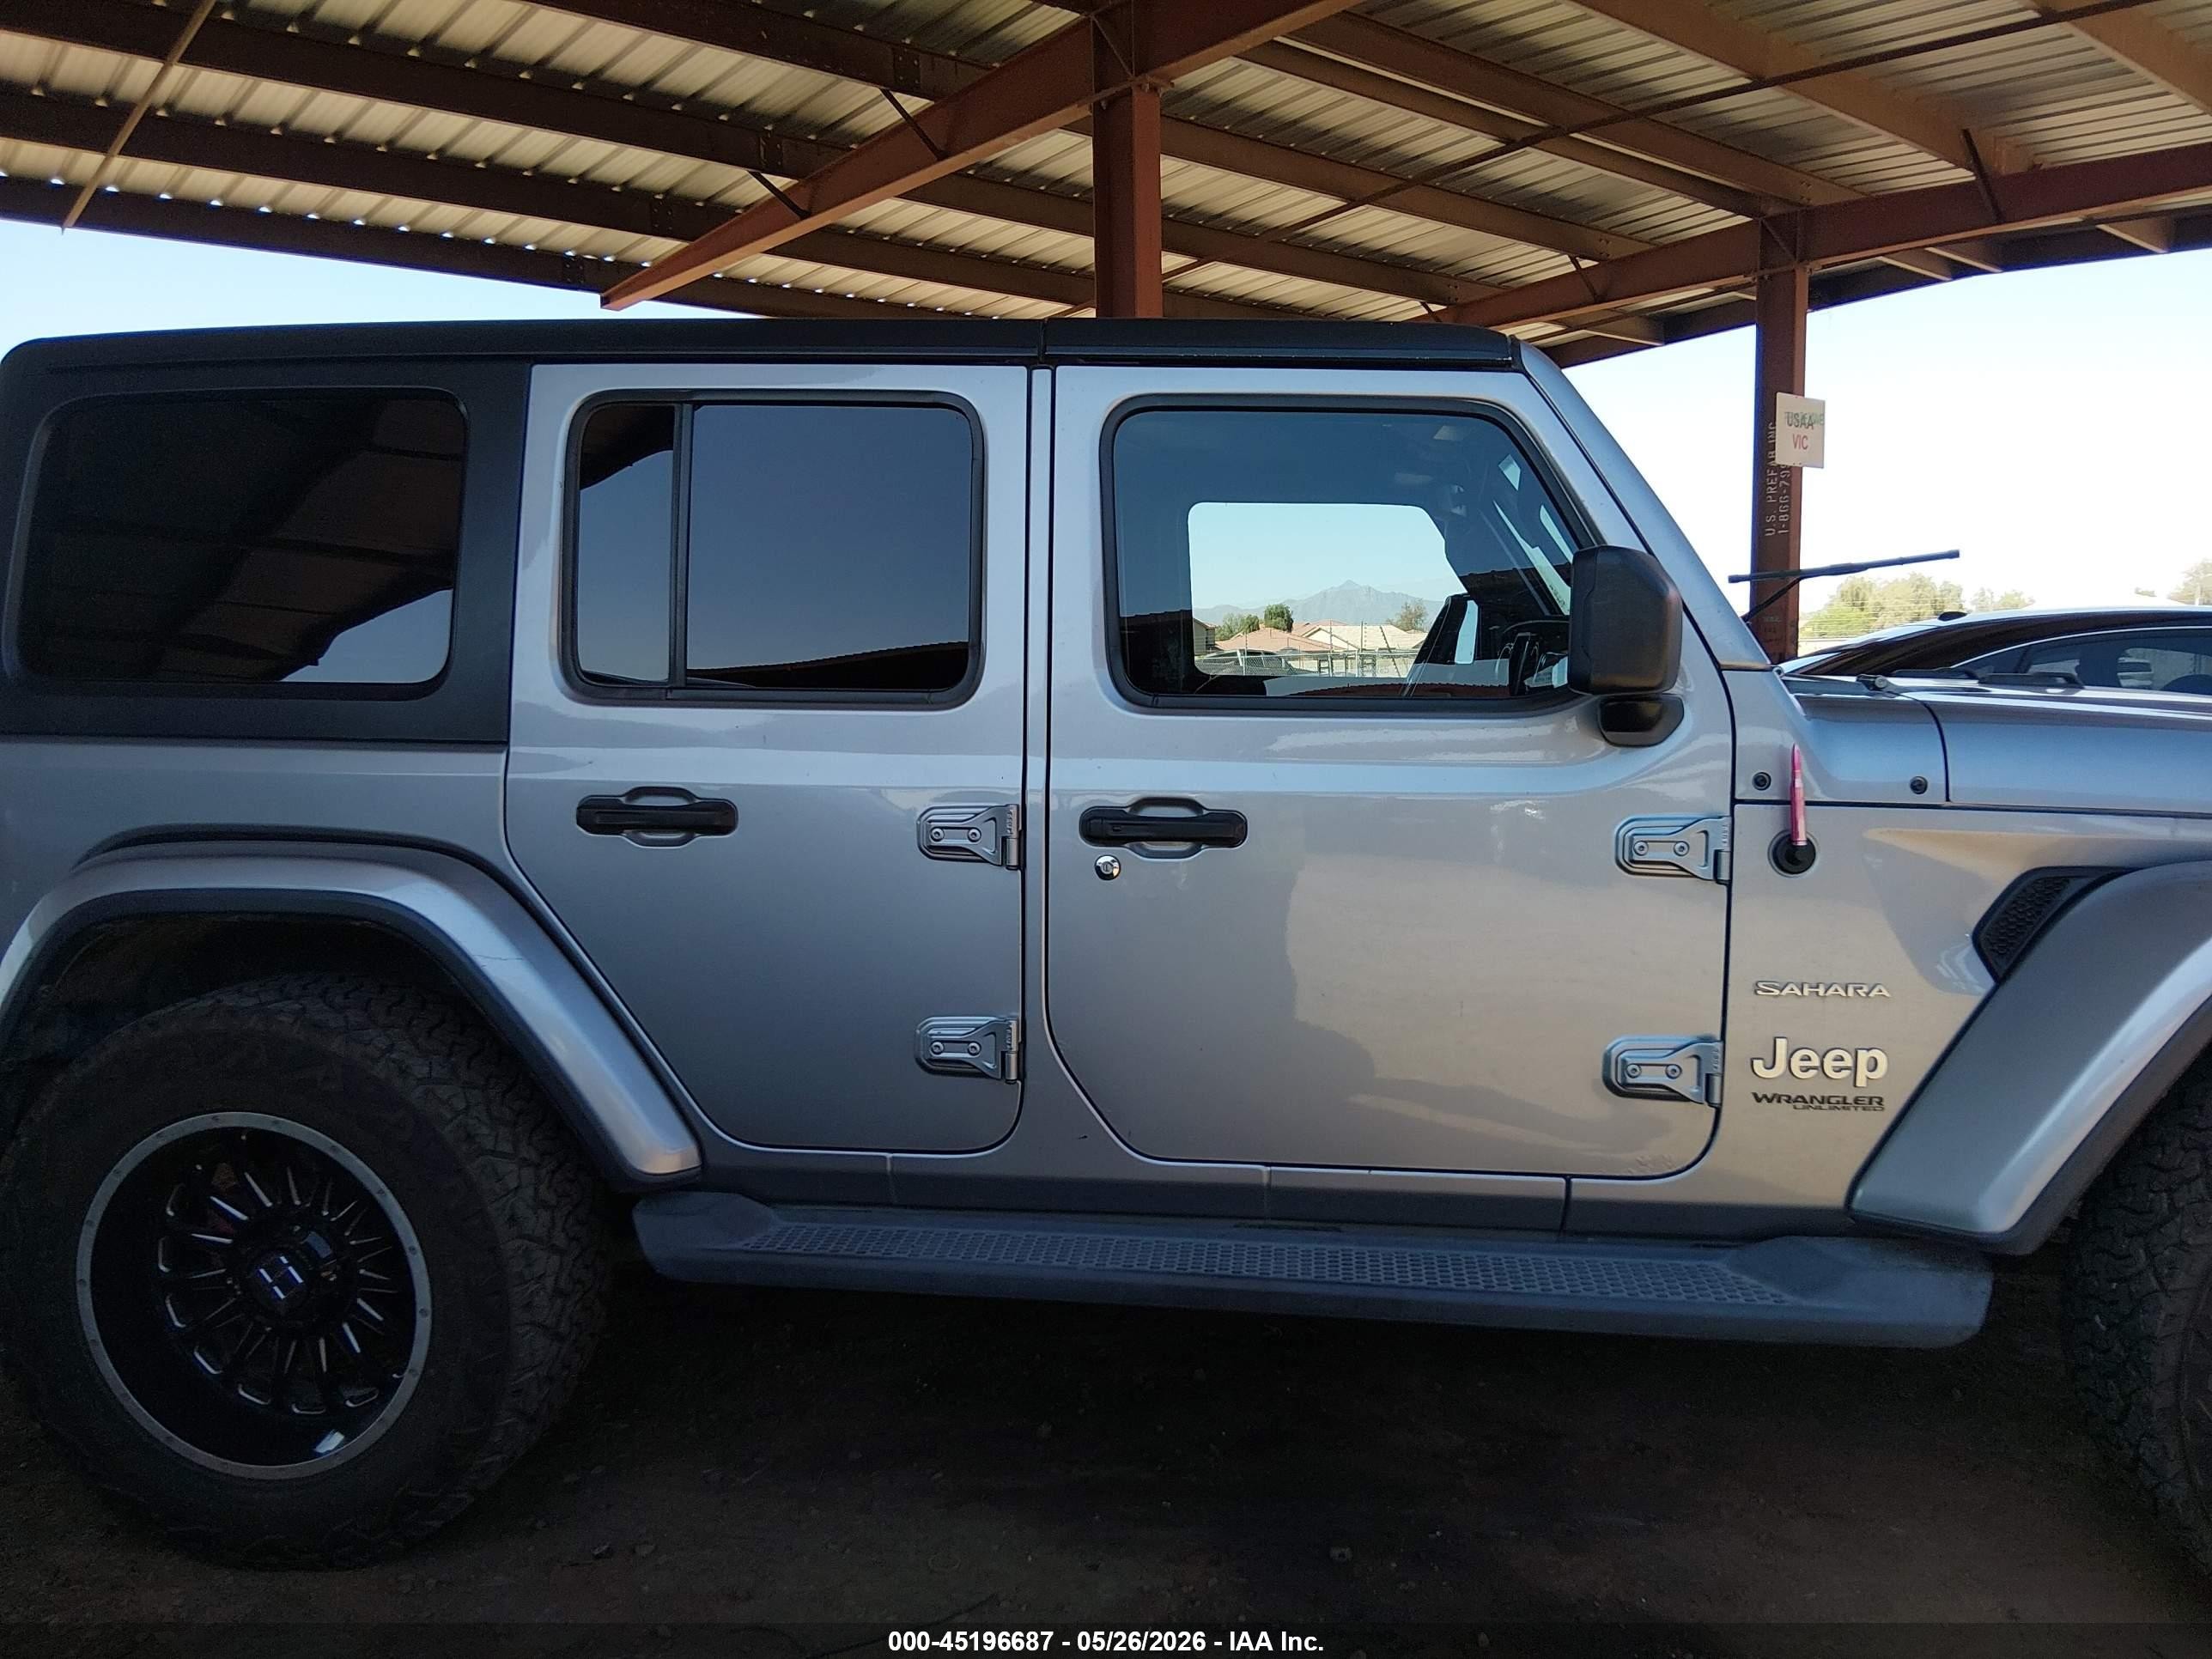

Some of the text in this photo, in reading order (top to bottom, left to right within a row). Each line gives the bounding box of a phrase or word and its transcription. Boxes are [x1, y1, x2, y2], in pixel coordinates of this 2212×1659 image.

[1792, 433, 1808, 450] VIC
[1764, 510, 1777, 537] U.S.
[1755, 981, 1891, 997] SAHARA
[1751, 1036, 1888, 1087] Jeep
[1752, 1092, 1883, 1106] WRANGLER
